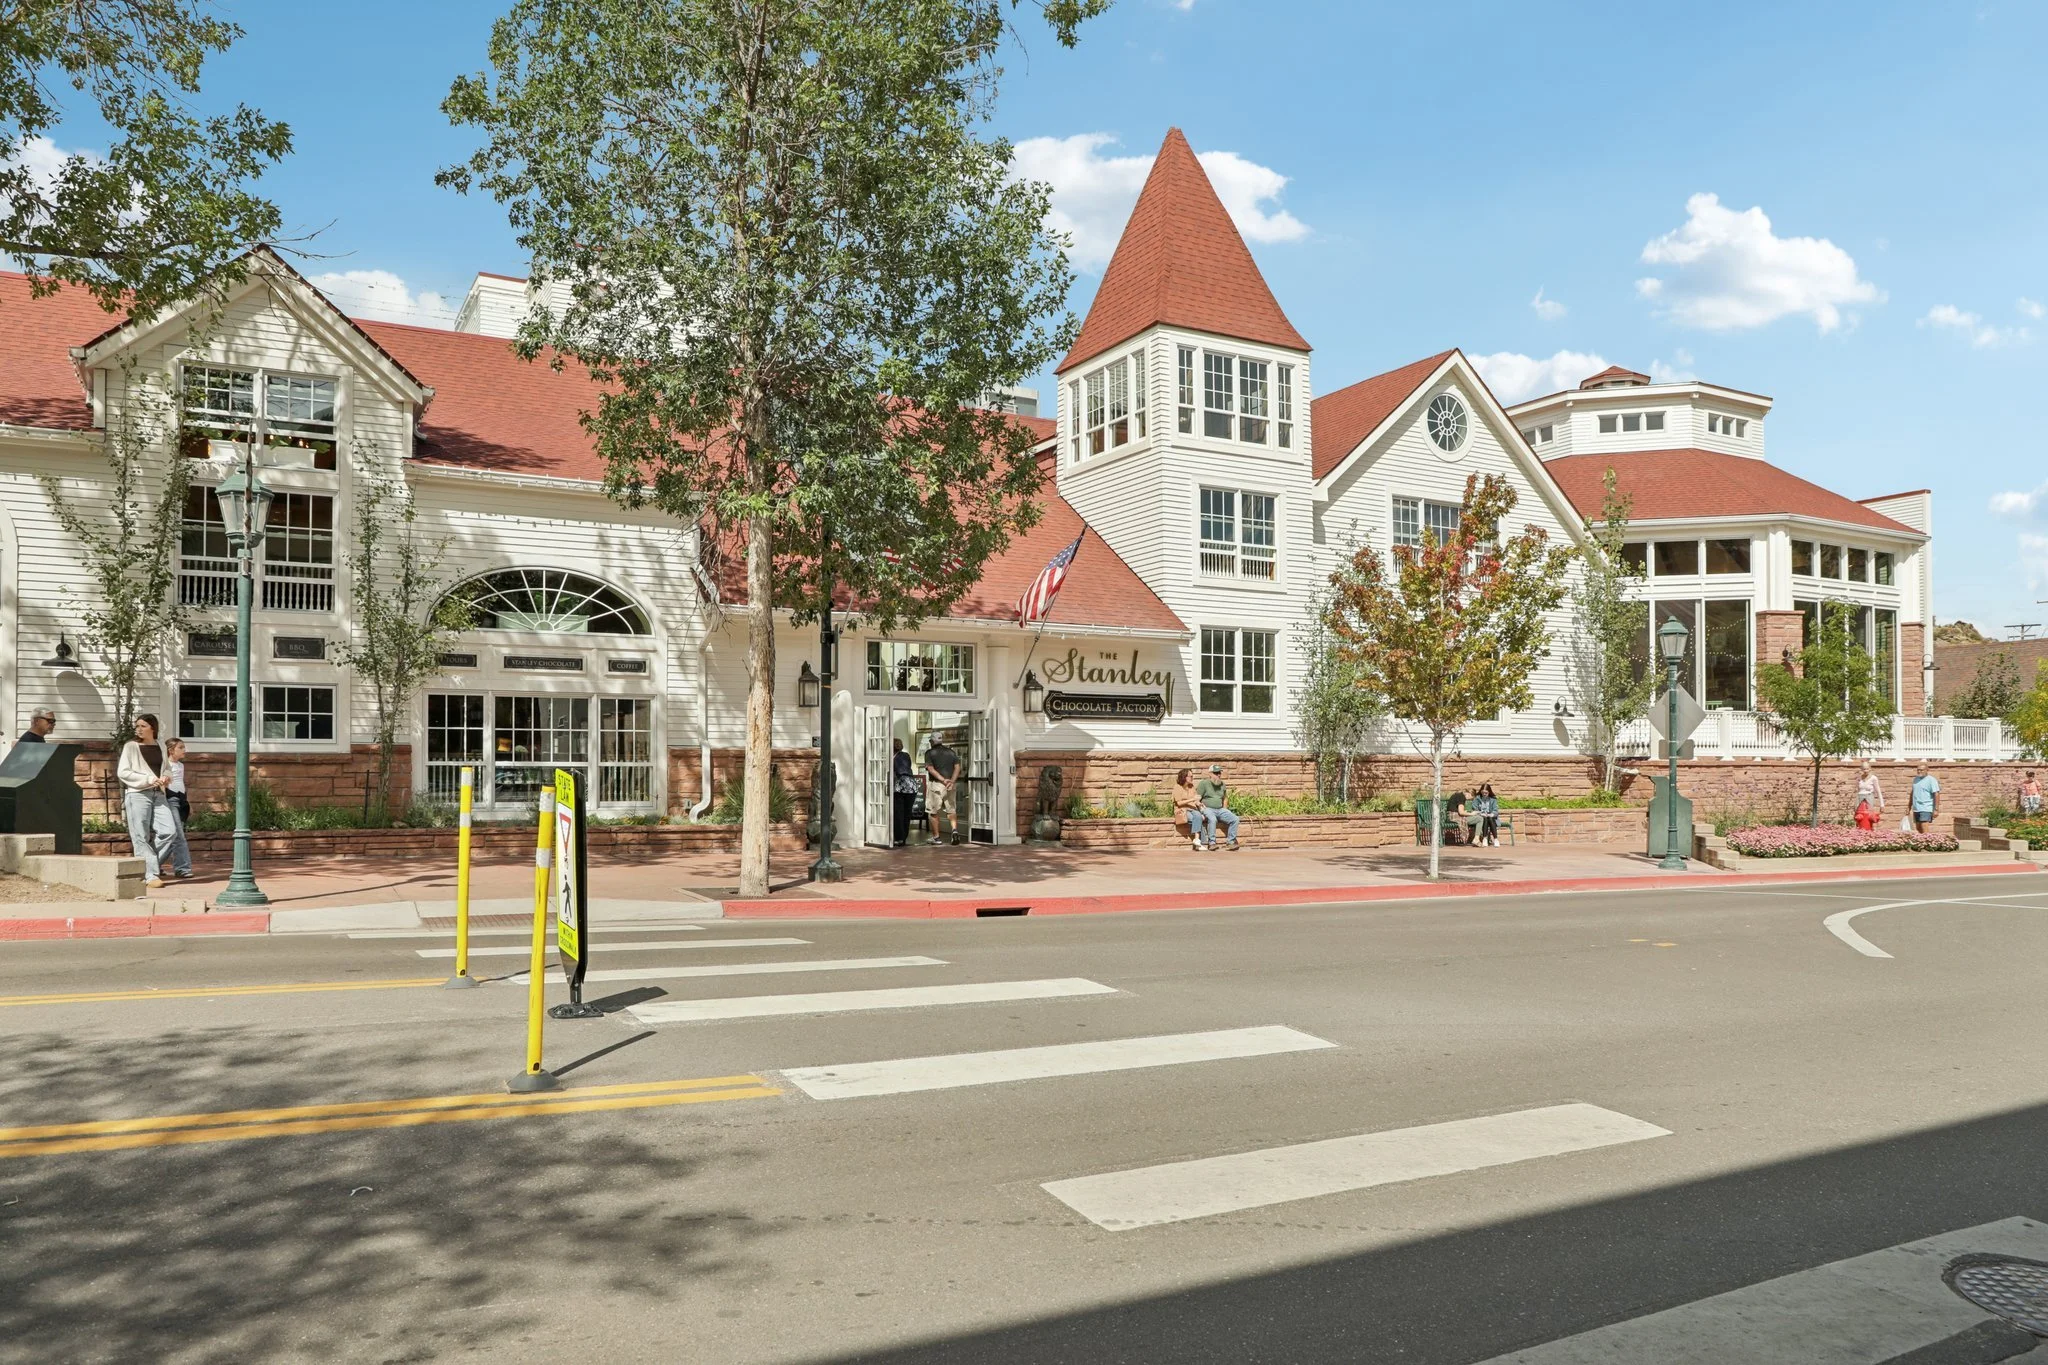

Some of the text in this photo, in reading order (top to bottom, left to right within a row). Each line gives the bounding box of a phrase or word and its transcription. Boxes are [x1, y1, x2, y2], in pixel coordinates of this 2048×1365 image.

[194, 641, 236, 649] CAROUSEL
[289, 644, 307, 652] BBQ
[1100, 651, 1118, 660] THE
[1042, 648, 1175, 717] Stanley
[1052, 700, 1158, 713] CHOCOLATE FACTORY
